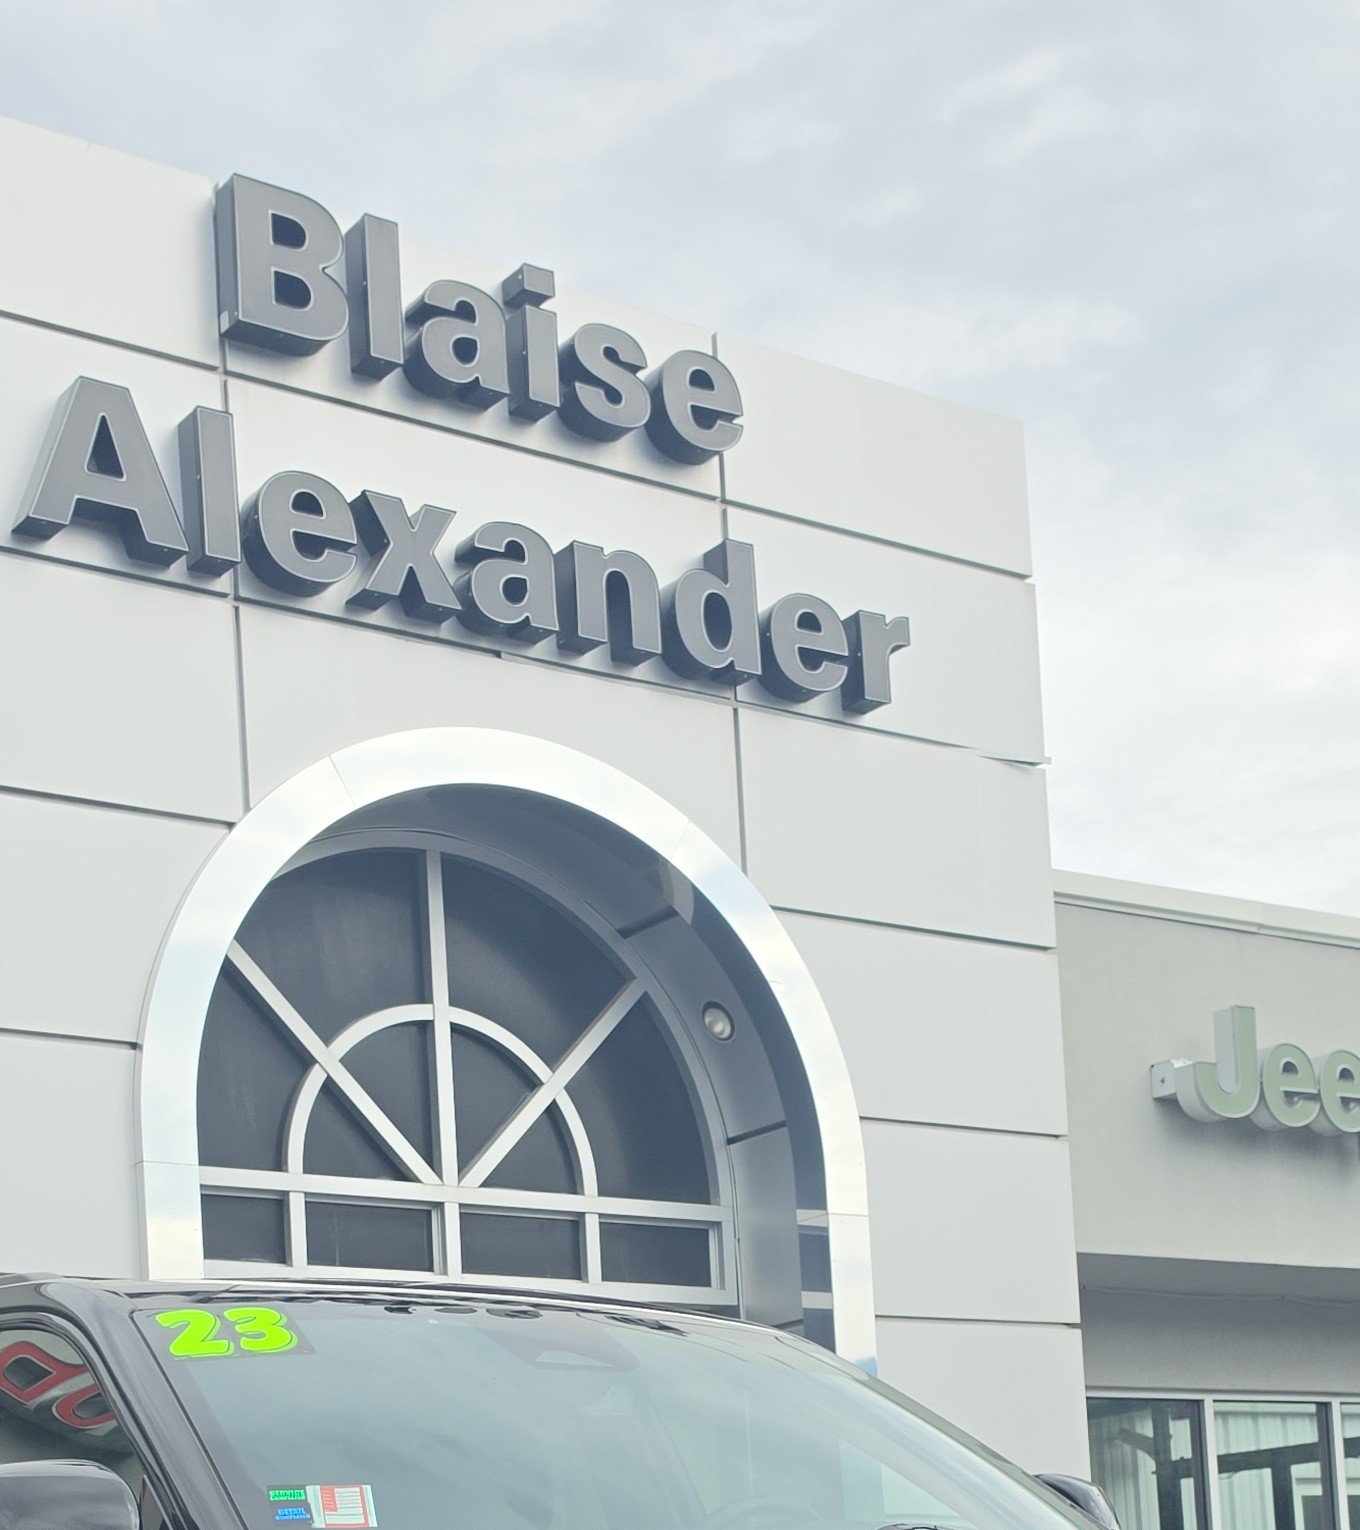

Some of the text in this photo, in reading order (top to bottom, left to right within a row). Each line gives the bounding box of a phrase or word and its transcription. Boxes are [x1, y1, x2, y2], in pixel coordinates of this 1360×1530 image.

[217, 173, 744, 465] Blaise
[12, 375, 910, 714] Alexander
[155, 1306, 298, 1358] 23
